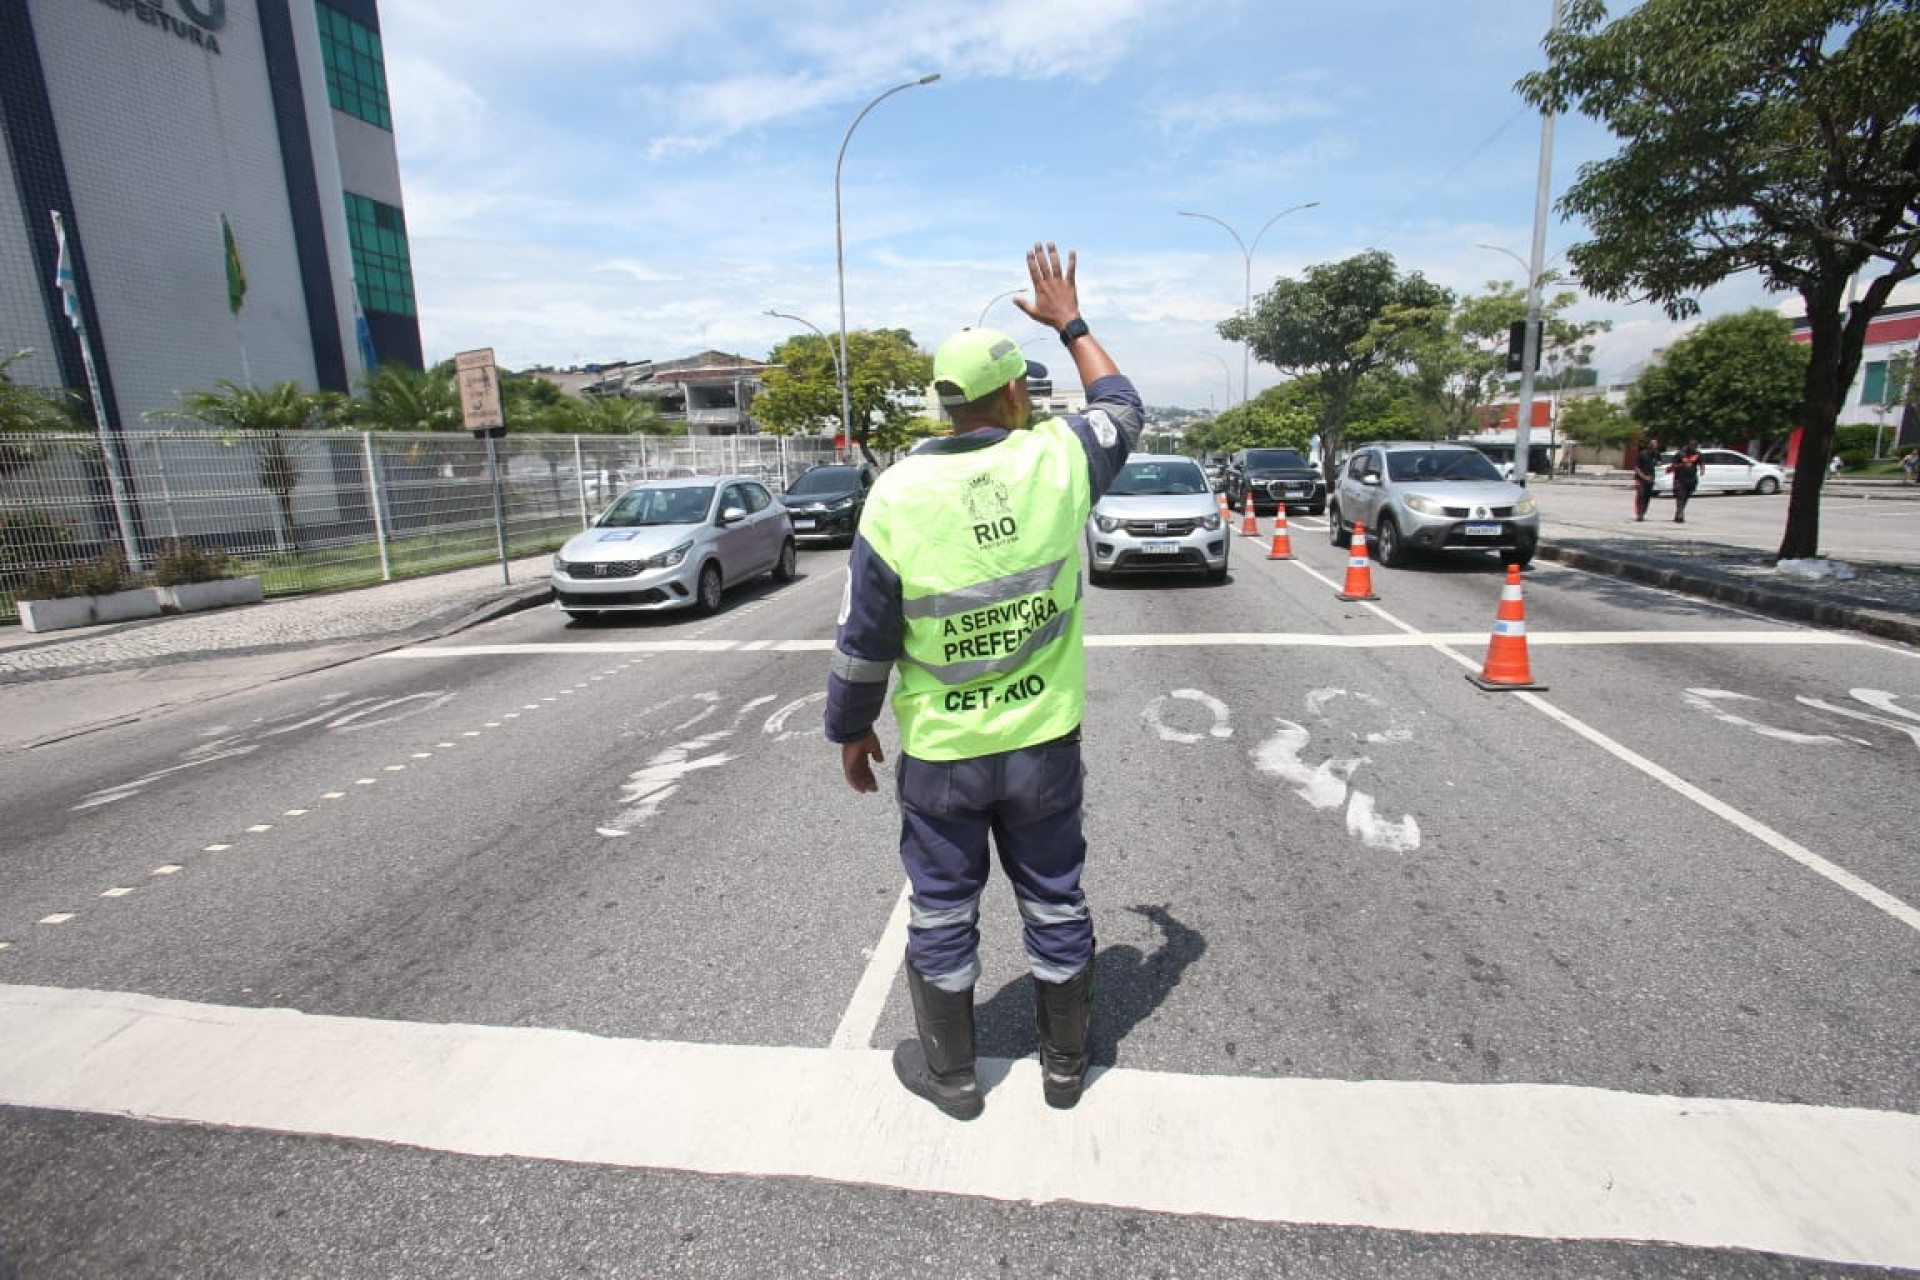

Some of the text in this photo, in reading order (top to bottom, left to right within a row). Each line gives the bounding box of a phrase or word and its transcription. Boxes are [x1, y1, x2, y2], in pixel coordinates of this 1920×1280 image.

[973, 516, 1016, 545] RIO
[944, 618, 958, 637] A
[944, 674, 1045, 711] CET-RIO
